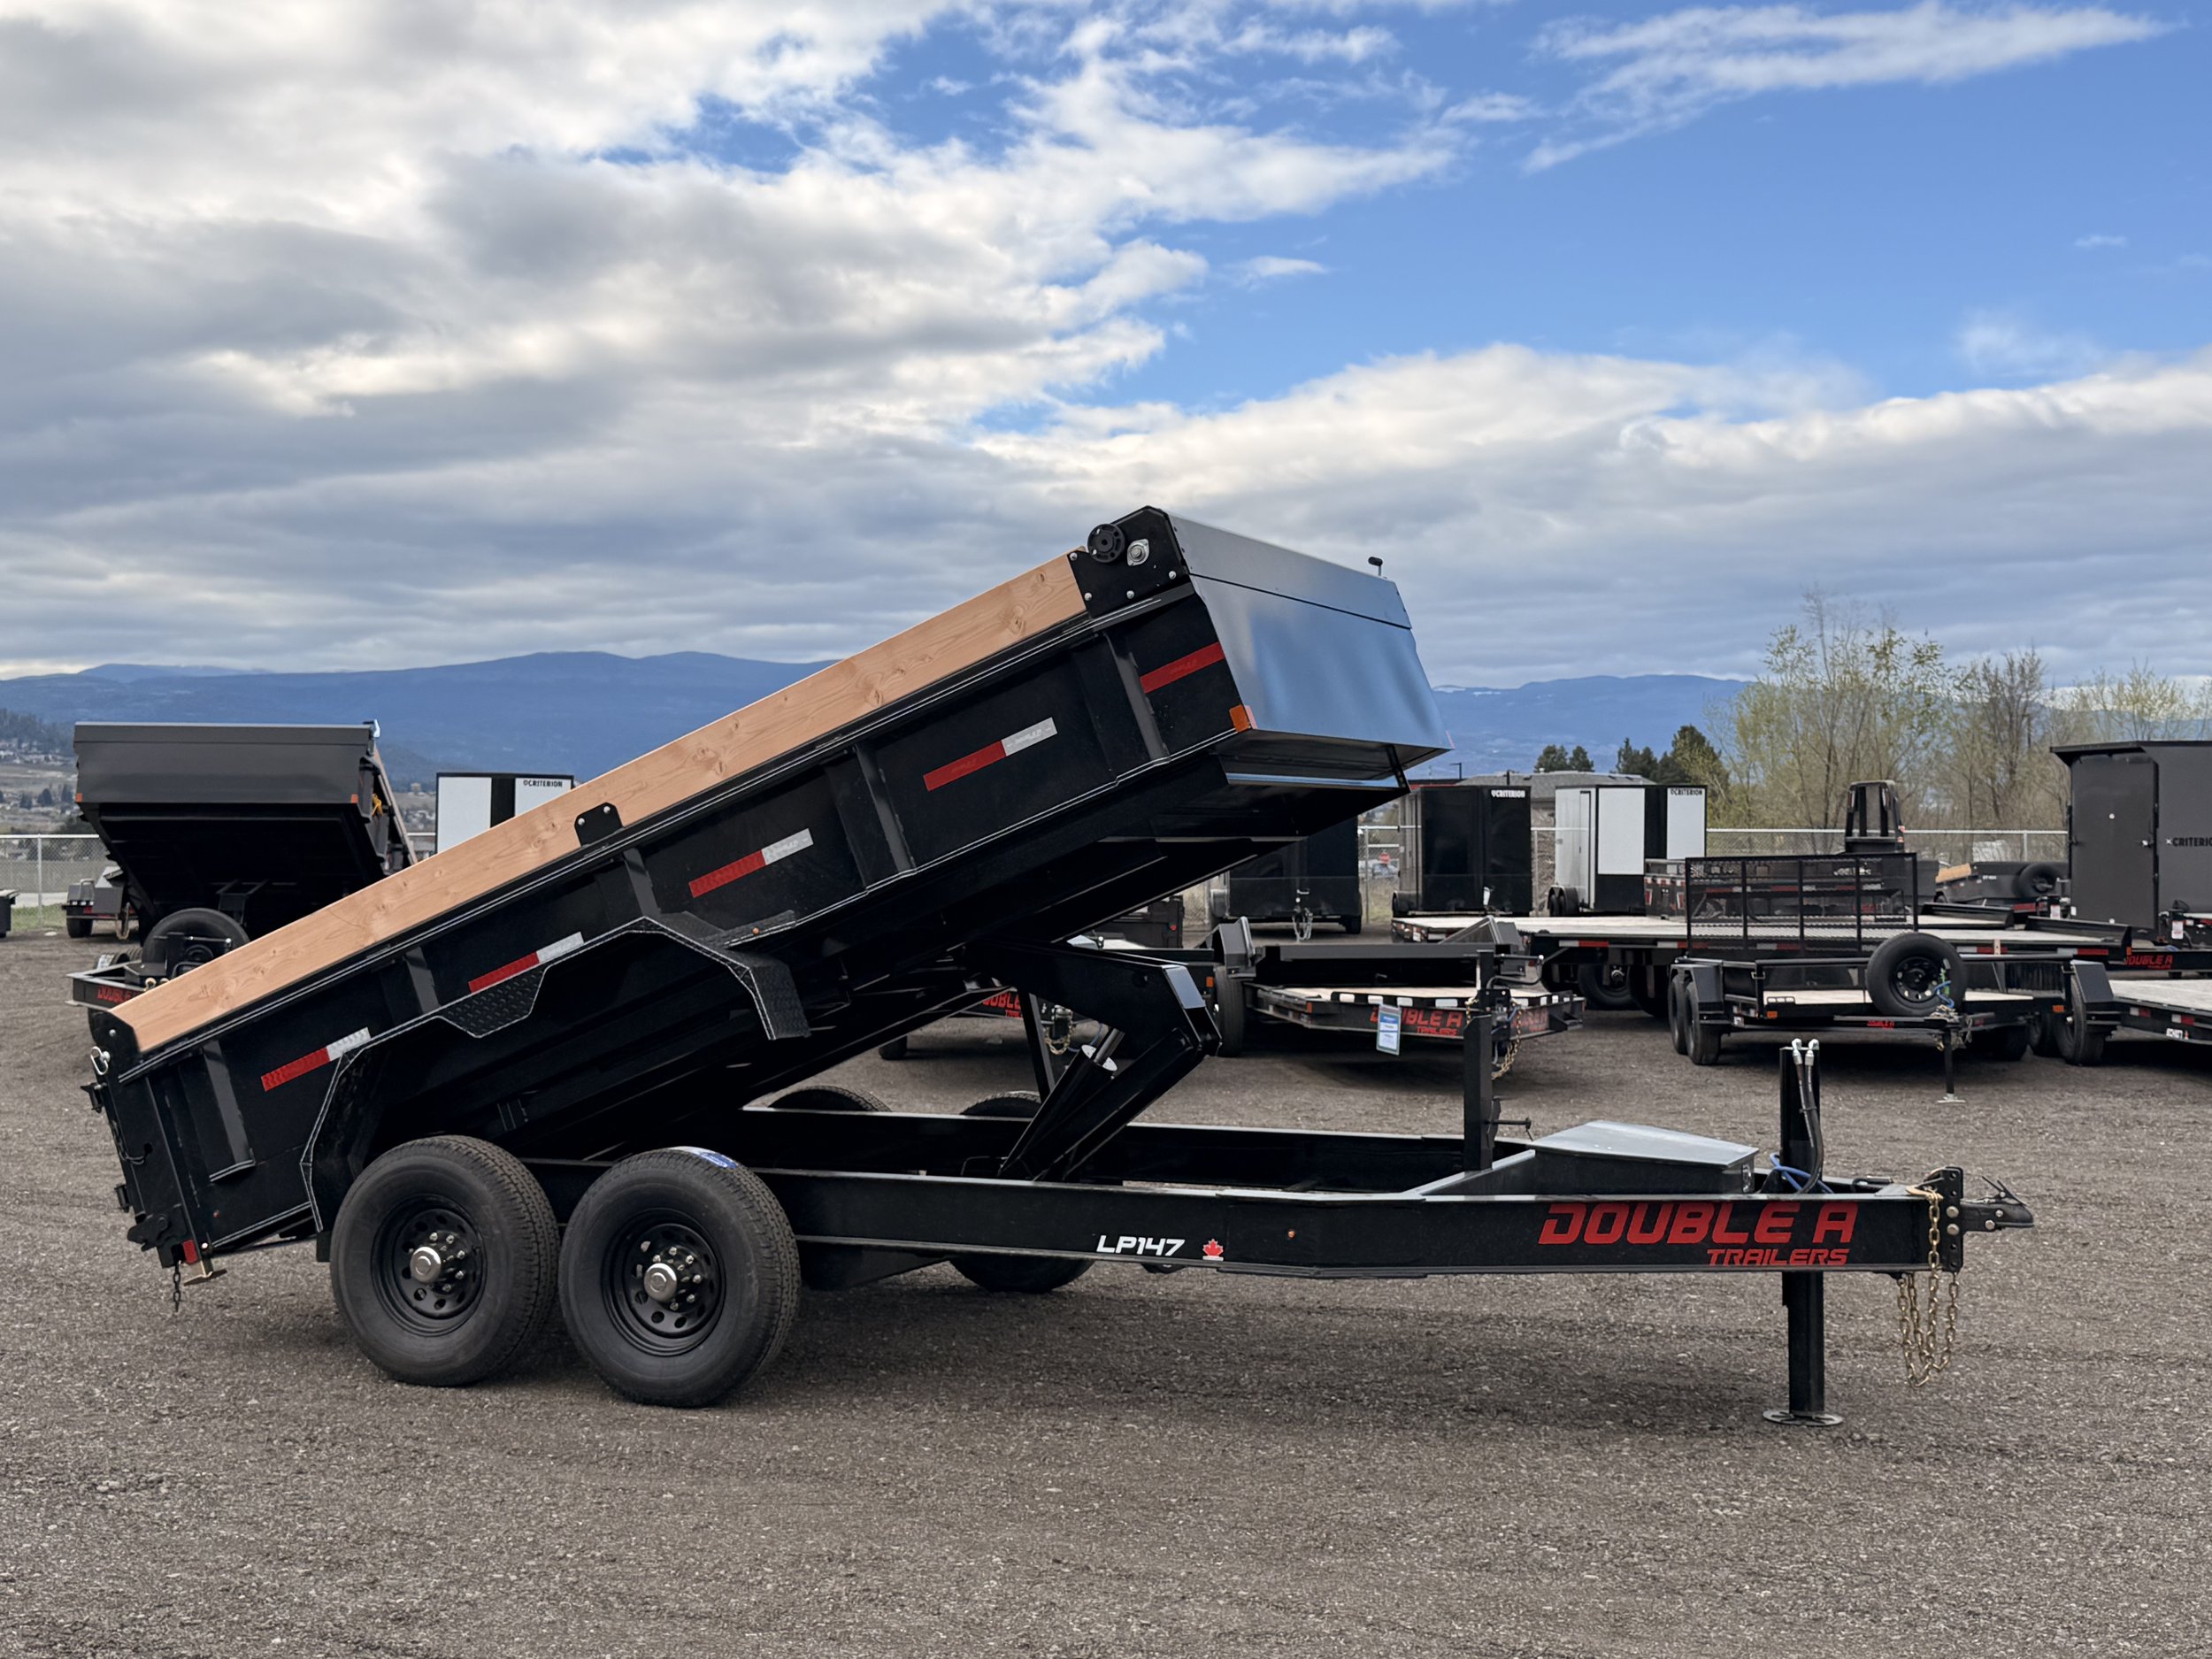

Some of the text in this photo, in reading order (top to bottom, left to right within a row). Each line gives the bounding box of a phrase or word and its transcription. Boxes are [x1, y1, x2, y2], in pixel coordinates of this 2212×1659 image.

[1446, 1011, 1463, 1028] A
[1538, 1202, 1858, 1245] DOUBLE A
[1096, 1235, 1186, 1256] LP147
[1707, 1248, 1850, 1267] TRAILERS
